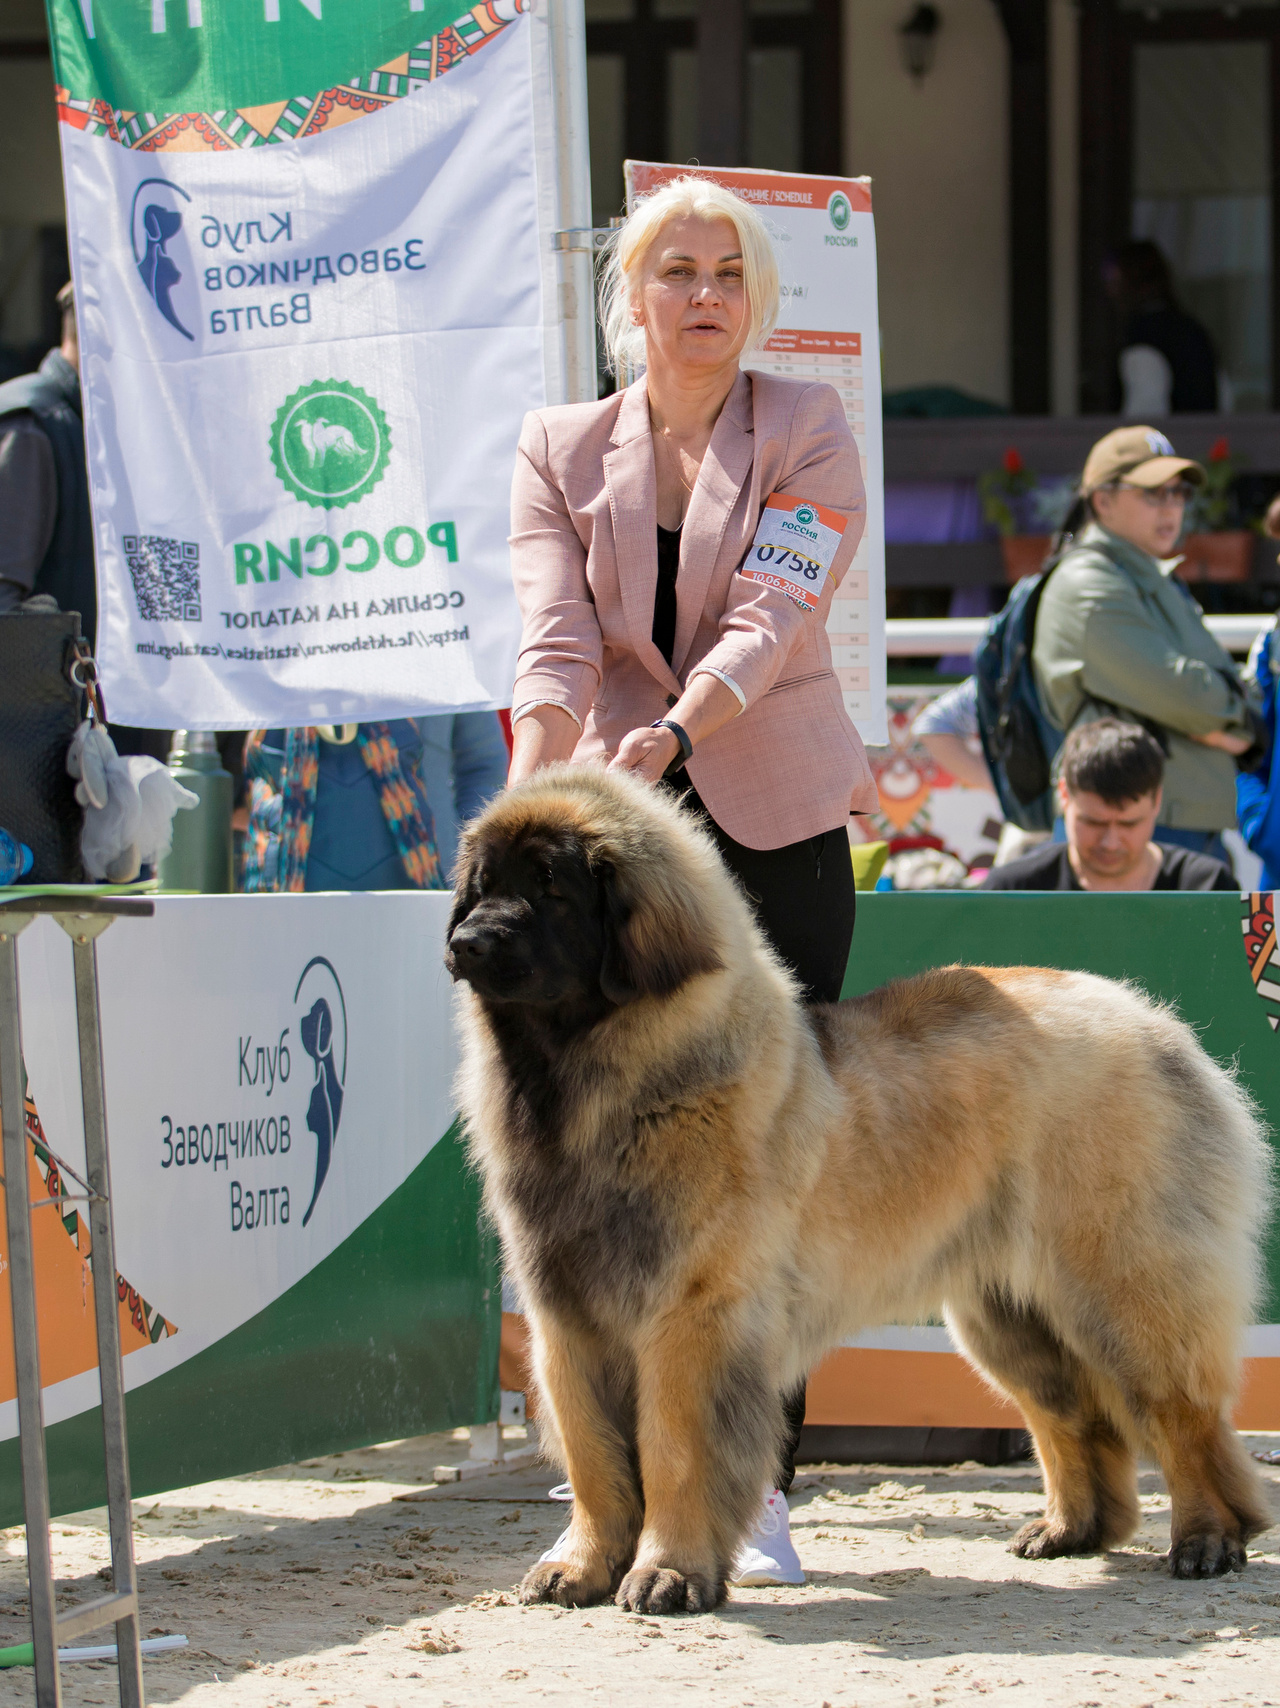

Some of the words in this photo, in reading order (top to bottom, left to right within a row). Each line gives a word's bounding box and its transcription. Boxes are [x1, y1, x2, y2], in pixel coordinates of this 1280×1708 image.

[775, 191, 814, 204] SCHEDULE
[824, 235, 859, 247] РОССИЯ
[781, 521, 818, 540] РОССИЯ
[756, 543, 820, 581] 0758
[752, 572, 808, 600] 10.06.2023
[239, 1028, 291, 1097] Клуб
[160, 1115, 292, 1172] Заводчиков
[230, 1180, 291, 1232] Валта
